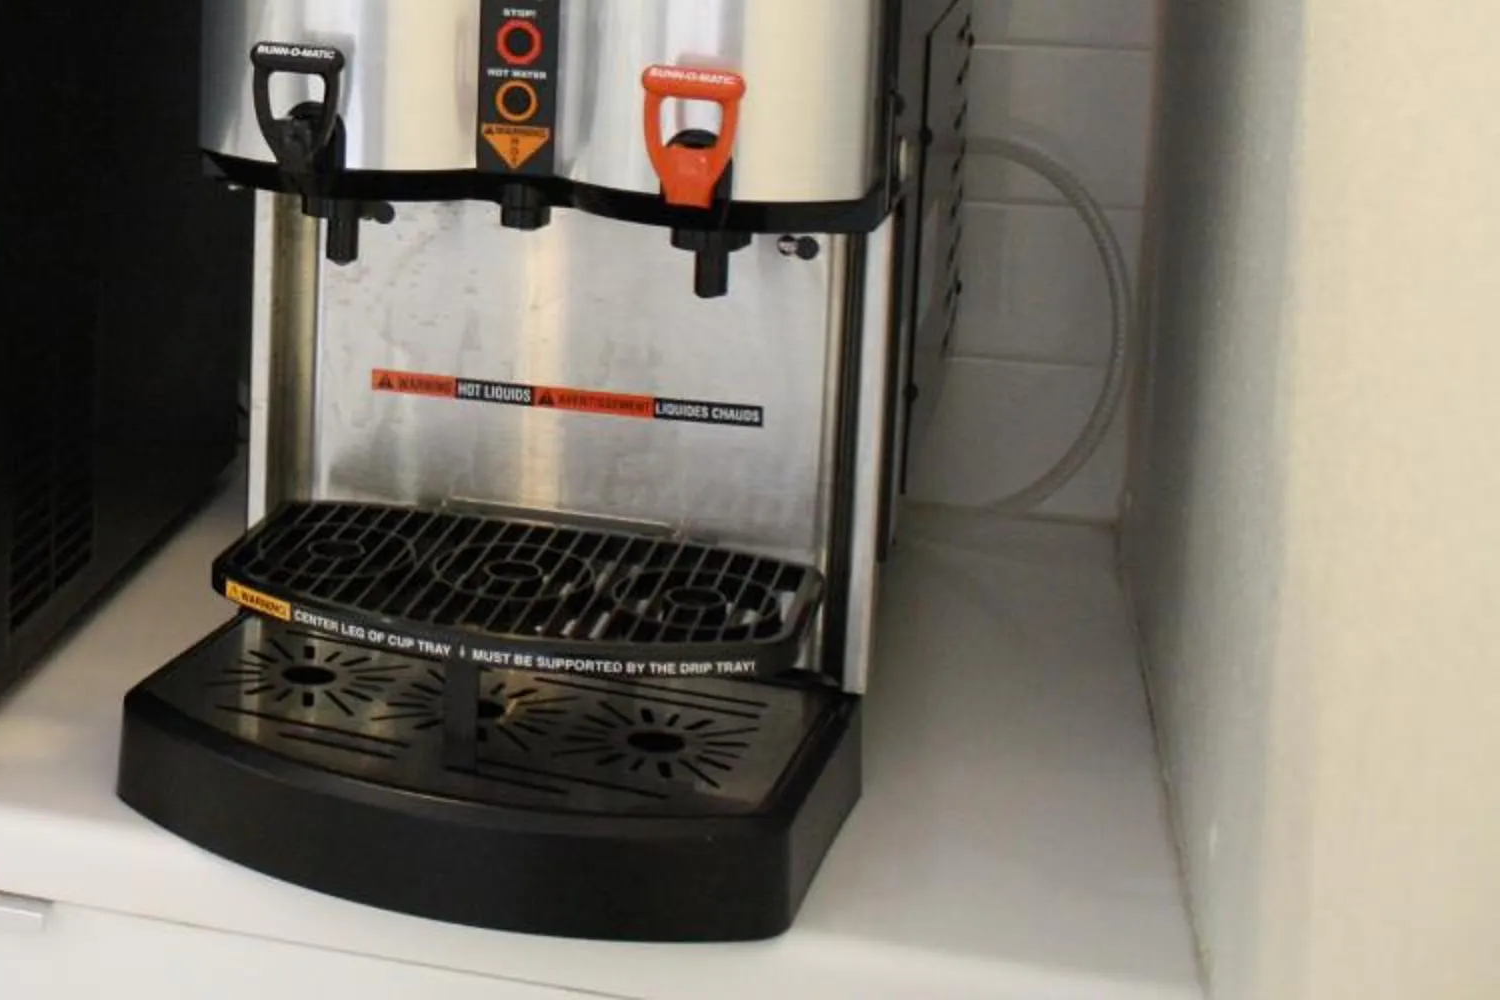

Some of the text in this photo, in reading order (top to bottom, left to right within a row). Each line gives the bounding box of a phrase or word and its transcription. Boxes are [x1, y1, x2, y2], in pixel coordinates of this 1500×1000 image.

[486, 68, 547, 80] HOT WATER
[457, 381, 481, 397] HOT
[484, 384, 531, 402] LIQUIDS
[655, 402, 709, 419] LIQUIDES
[711, 407, 759, 422] CHAUDS
[293, 608, 338, 632] CENTER
[341, 624, 365, 640] LEG
[368, 630, 386, 643] OF
[388, 634, 415, 648] CUP
[417, 640, 451, 656] TRAY
[471, 648, 511, 665] MUST
[514, 653, 533, 667] BE
[536, 655, 623, 673] SUPPORTED
[626, 661, 645, 673] BY
[649, 661, 676, 674] THE
[680, 661, 712, 674] DRIP
